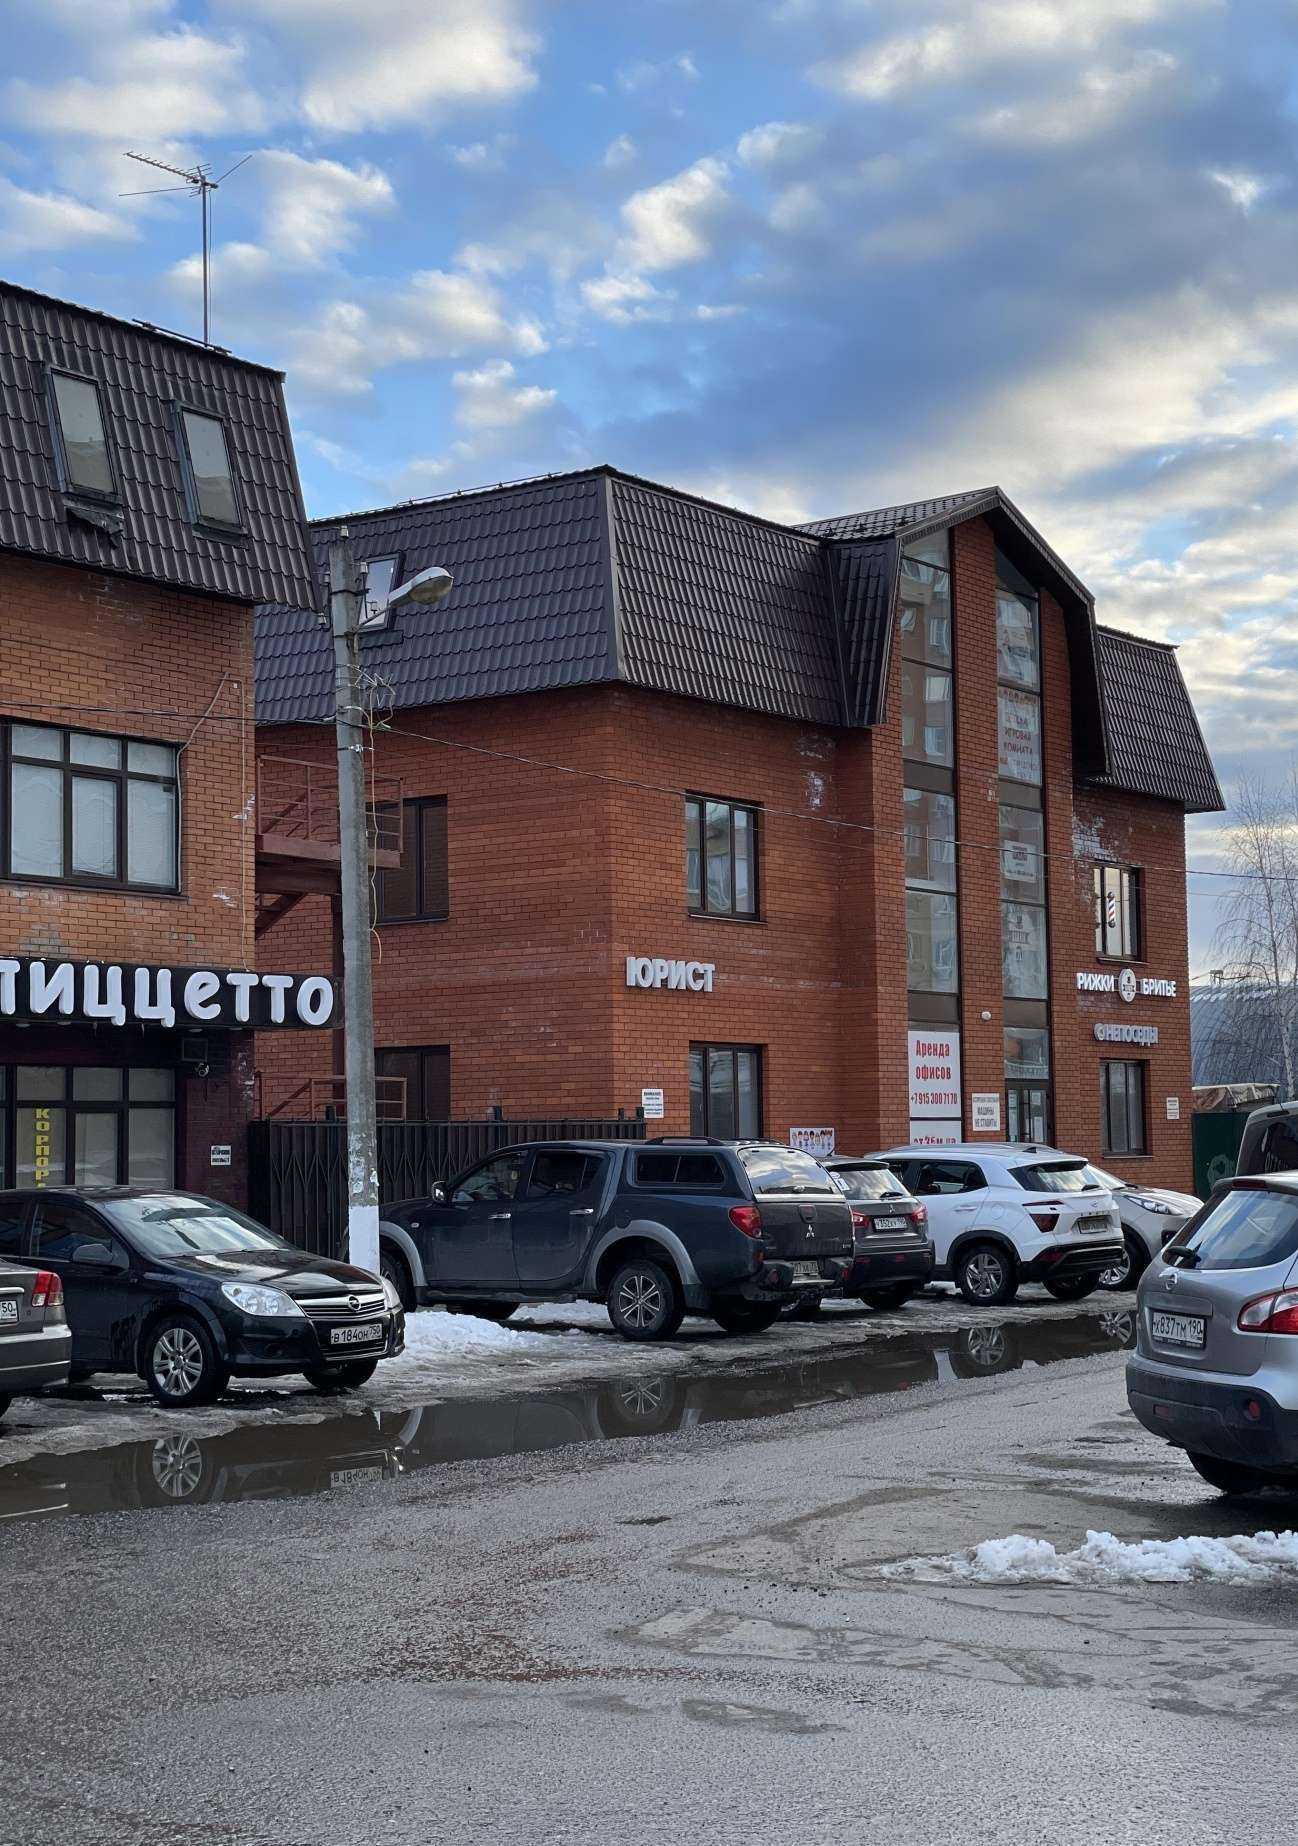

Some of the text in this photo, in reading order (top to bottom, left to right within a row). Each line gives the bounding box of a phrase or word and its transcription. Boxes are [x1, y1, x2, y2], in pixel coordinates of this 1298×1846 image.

[626, 956, 716, 992] ЮРИСТ
[1142, 978, 1177, 997] БРИТЬЕ
[915, 1039, 950, 1058] Аренда
[915, 1064, 952, 1081] офисов
[1188, 1319, 1202, 1335] 190
